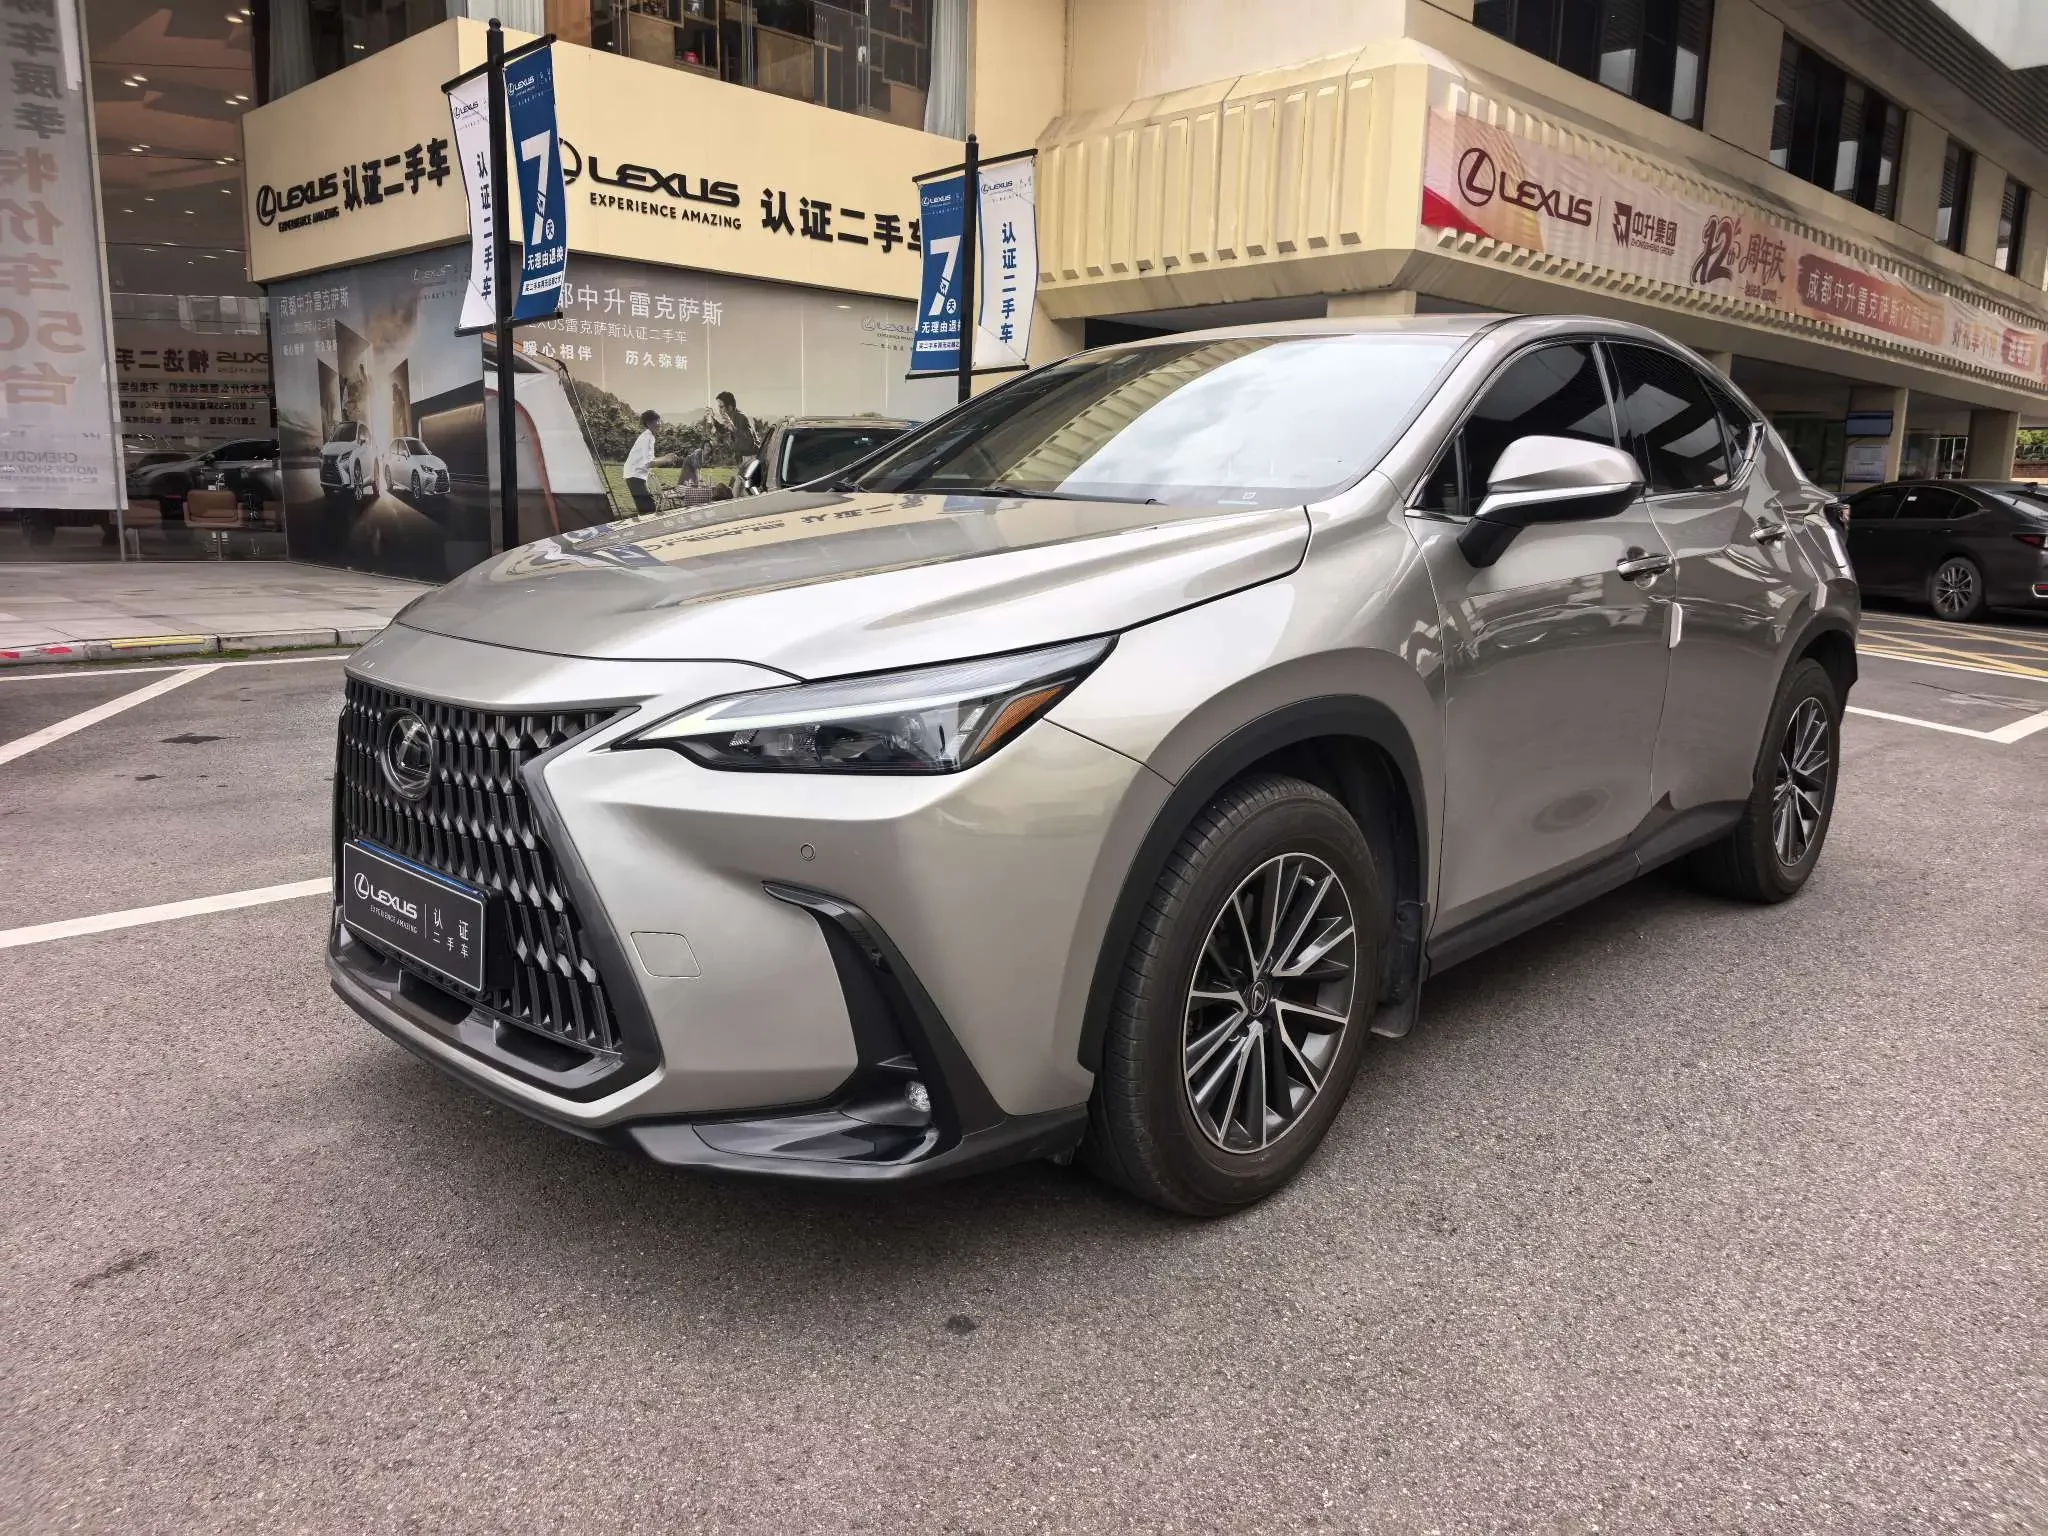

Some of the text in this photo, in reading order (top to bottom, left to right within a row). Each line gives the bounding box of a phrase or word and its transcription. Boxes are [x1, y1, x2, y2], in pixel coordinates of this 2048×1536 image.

[515, 75, 535, 91] LEXUS
[460, 101, 479, 115] LEXUS
[276, 138, 450, 212] LEXUS 认证二手车
[588, 156, 740, 208] LEXUS
[989, 180, 1013, 191] LEXUS
[590, 192, 742, 230] EXPERIENCE AMAZING
[929, 195, 951, 204] LEXUS
[1500, 171, 1592, 227] LEXUS
[1632, 211, 1678, 247] 中升集团
[476, 152, 493, 300] 认证二手车
[928, 234, 961, 317] 7
[1000, 221, 1017, 344] 认证二手车
[523, 340, 688, 371] 暖心相伴 历久弥新
[371, 885, 418, 919] LEXUS
[433, 931, 468, 958] 二手车
